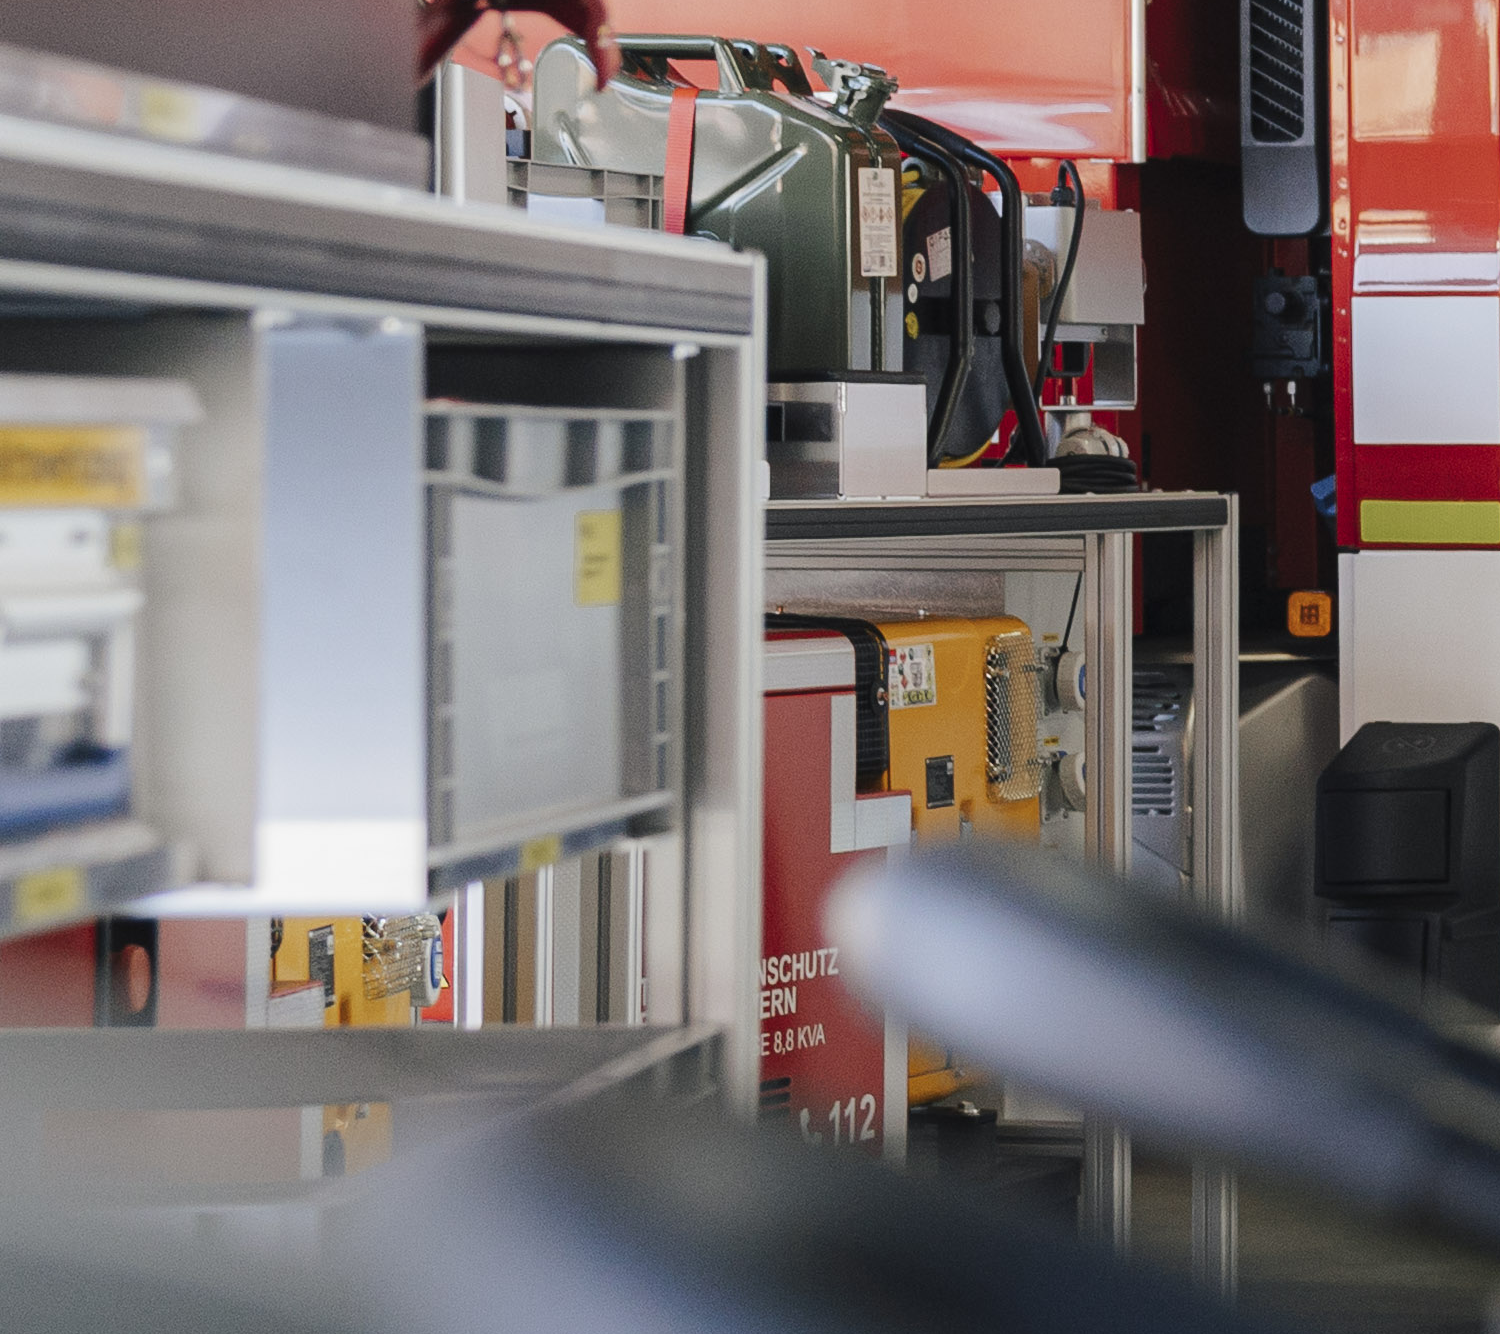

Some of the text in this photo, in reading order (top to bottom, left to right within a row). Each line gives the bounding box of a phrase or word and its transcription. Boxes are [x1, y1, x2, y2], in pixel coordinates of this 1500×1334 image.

[774, 1028, 794, 1055] 8,8
[798, 1023, 826, 1049] KVA
[829, 1093, 876, 1147] 112
